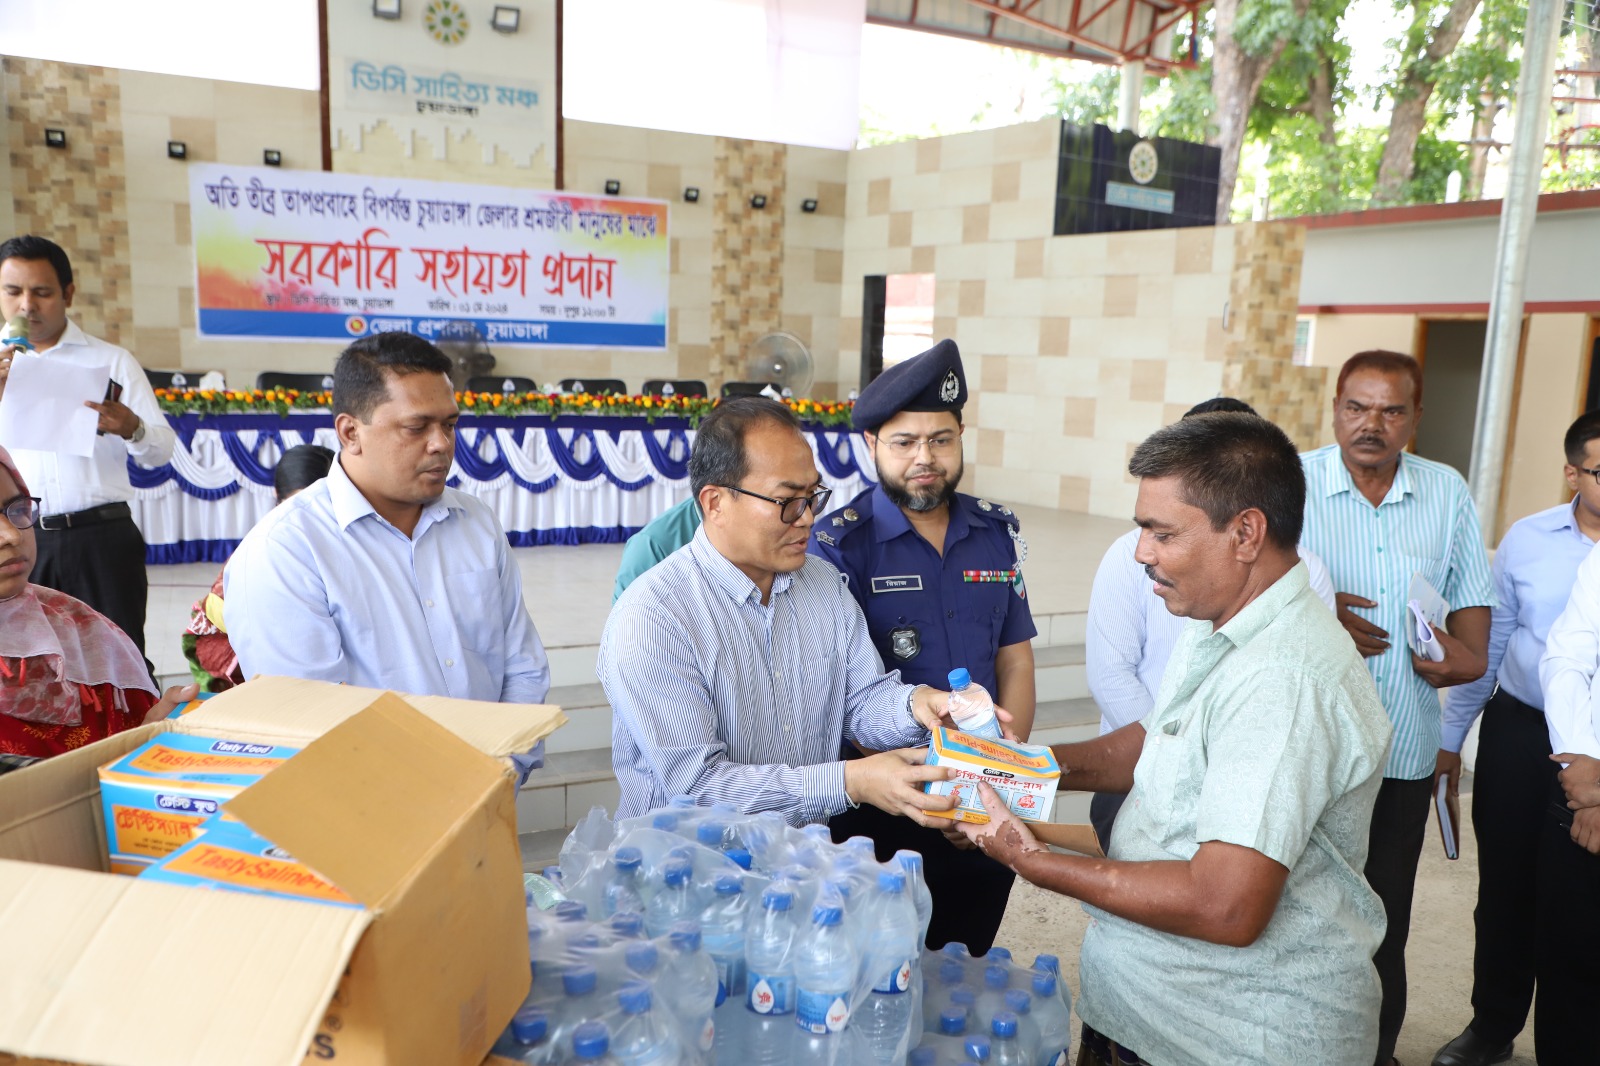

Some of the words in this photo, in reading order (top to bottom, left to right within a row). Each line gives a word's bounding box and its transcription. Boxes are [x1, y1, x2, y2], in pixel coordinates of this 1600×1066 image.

[351, 61, 406, 94] ডিসি
[413, 72, 490, 104] সাহিত্য
[495, 85, 539, 109] মঞ্চ
[204, 175, 239, 210] অতি
[245, 176, 277, 217] তীব্র
[281, 188, 360, 221] তাপপ্রবাহে
[363, 186, 413, 222] বিপর্যস্ত
[417, 199, 471, 230] চুয়াডাঙ্গা
[477, 203, 518, 230] জেলার
[523, 198, 573, 235] শ্রমজীবী
[578, 208, 624, 241] মানুষের
[627, 213, 659, 239] মাঝে
[255, 227, 402, 290] সরকারি
[411, 246, 531, 298] সহায়তা
[541, 251, 618, 300] প্রদান
[486, 320, 549, 342] চুয়াডাঙ্গা
[215, 742, 241, 753] Tasty
[243, 744, 270, 754] Food
